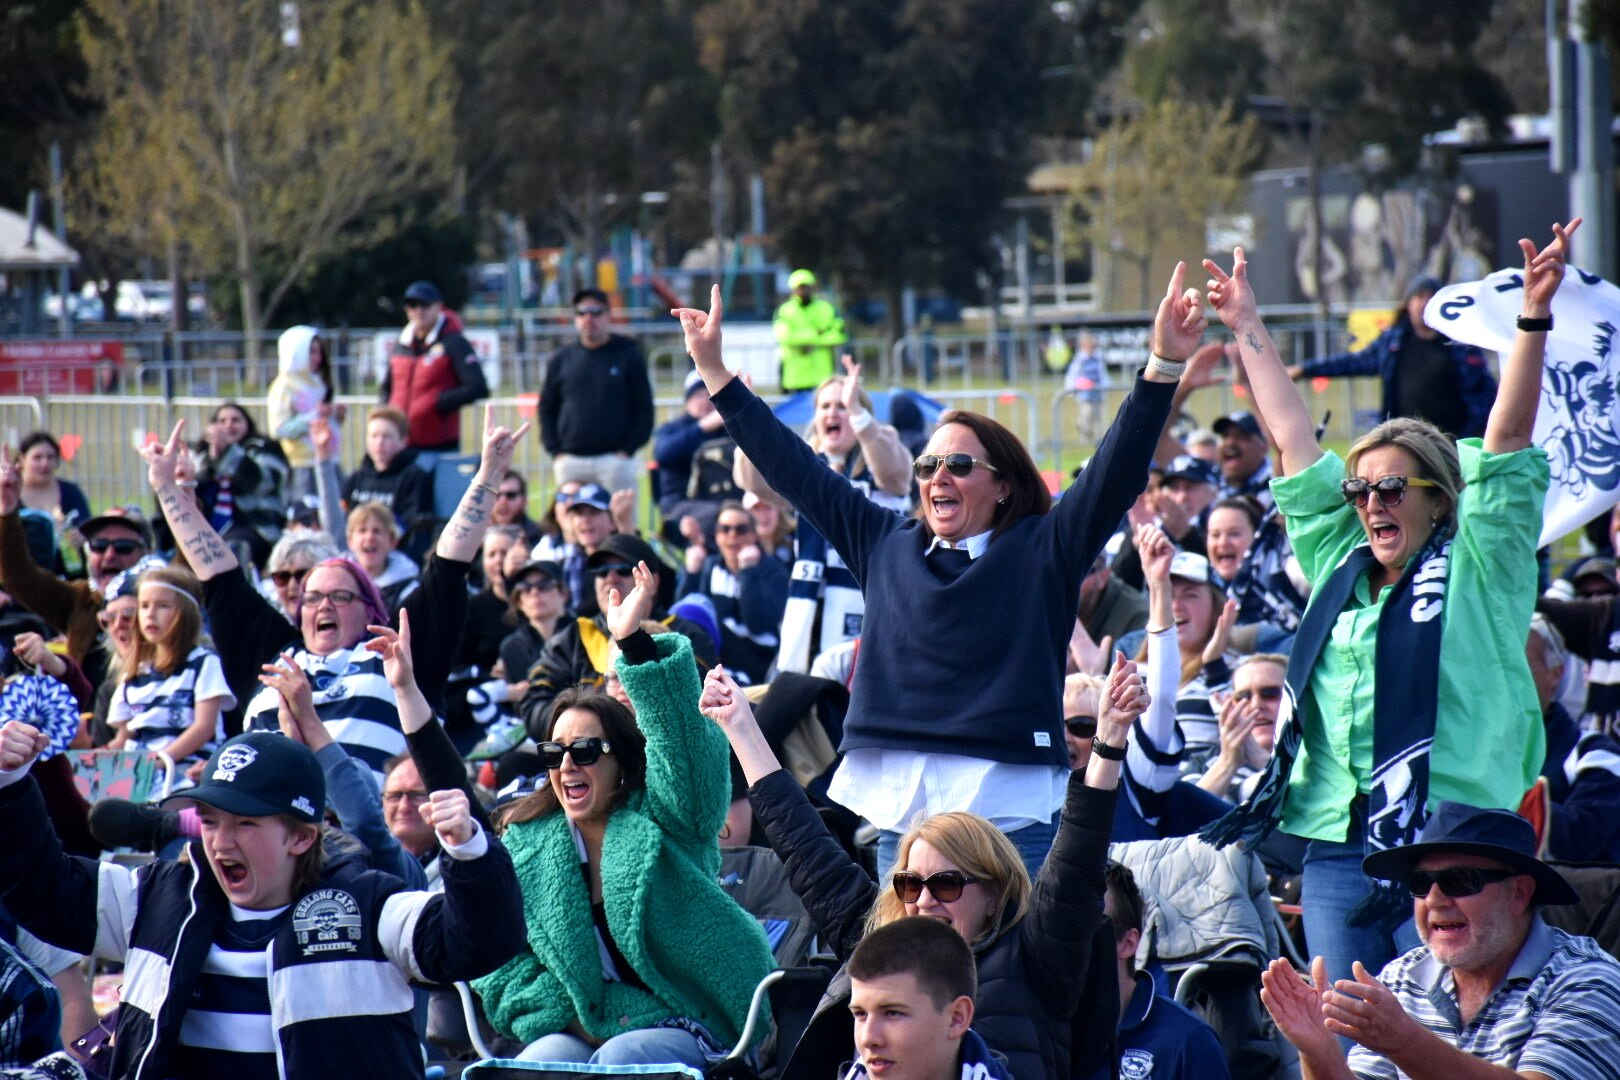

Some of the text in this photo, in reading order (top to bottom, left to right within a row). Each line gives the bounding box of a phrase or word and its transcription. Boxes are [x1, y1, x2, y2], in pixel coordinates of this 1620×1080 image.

[295, 890, 357, 918] GEELONG CATS
[317, 930, 339, 941] CATS
